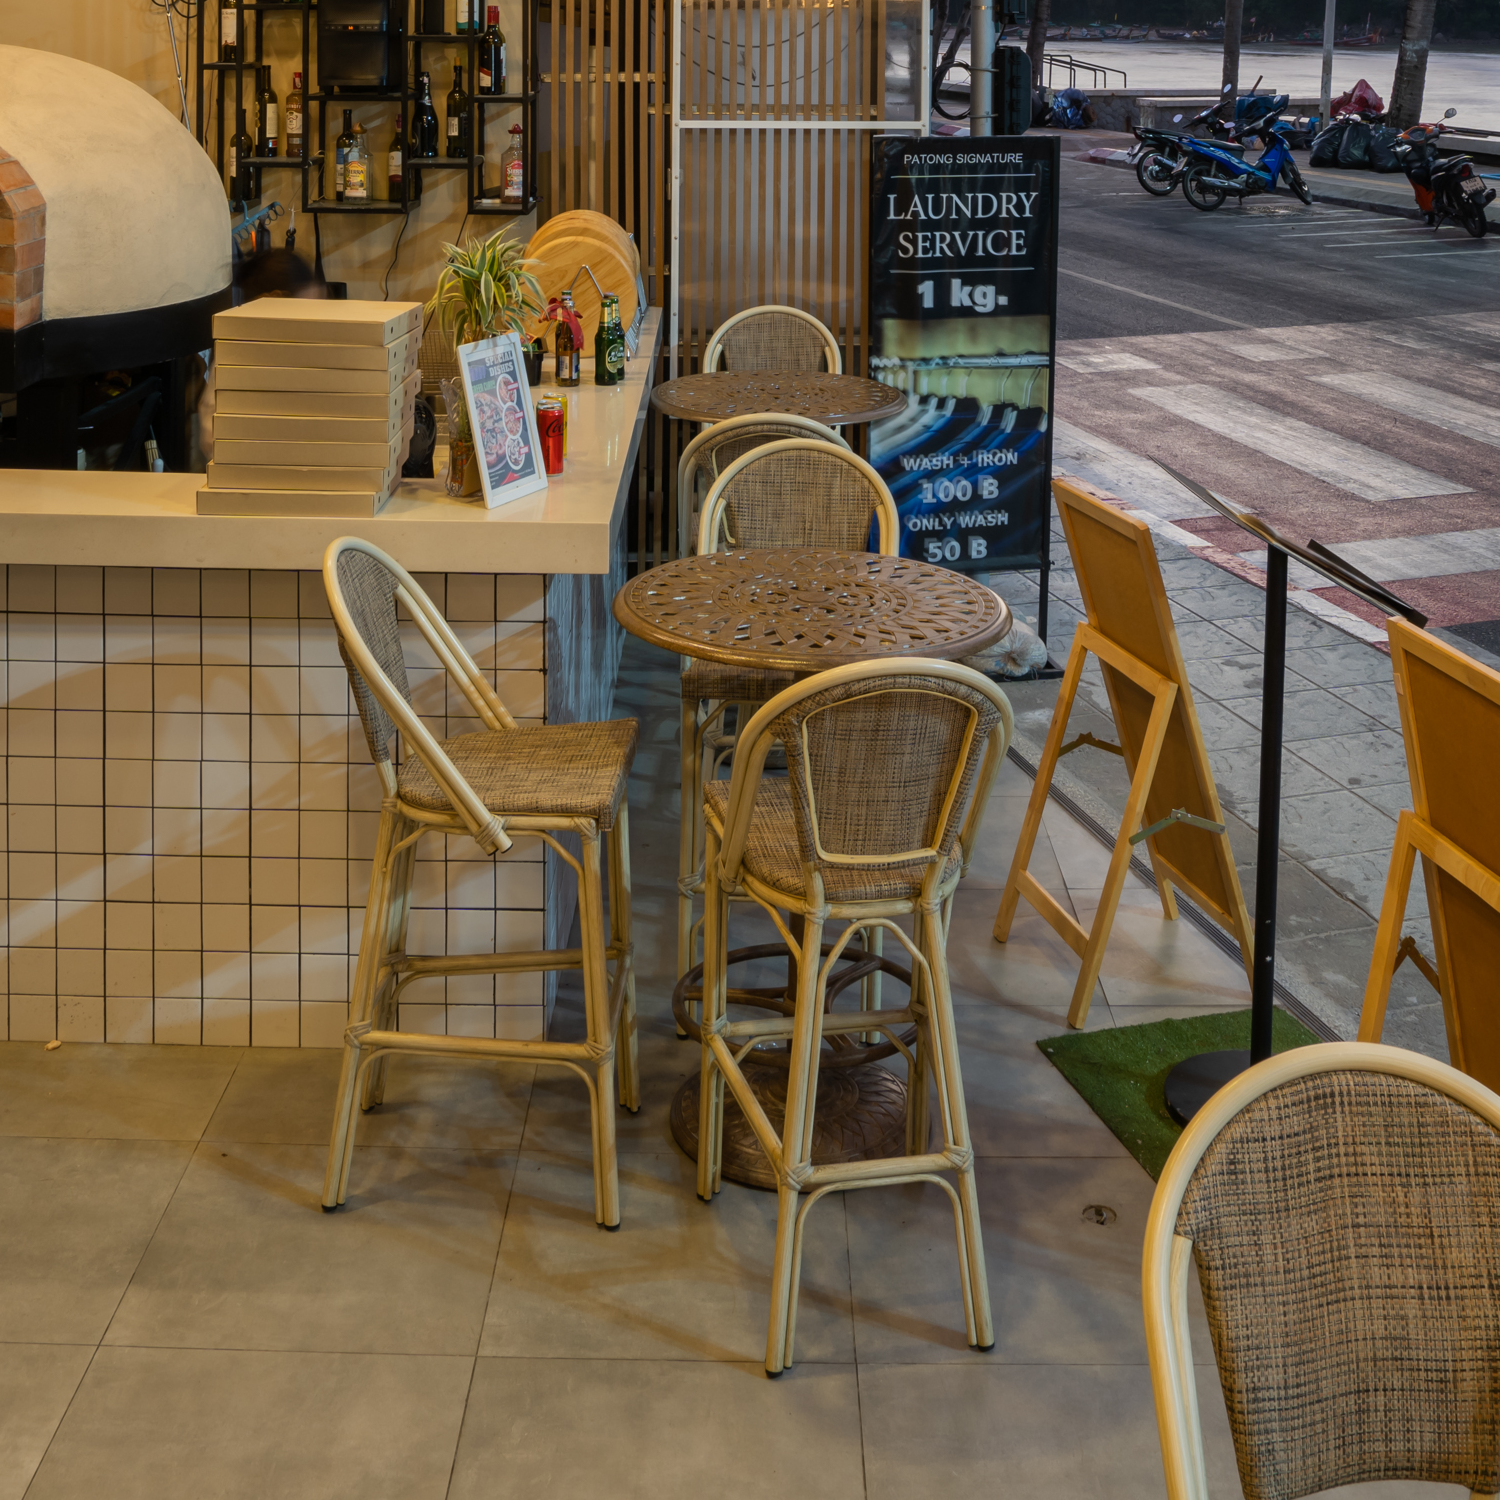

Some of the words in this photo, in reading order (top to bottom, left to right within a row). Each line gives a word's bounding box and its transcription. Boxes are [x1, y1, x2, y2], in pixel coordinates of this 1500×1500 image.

[904, 154, 953, 165] PATONG
[956, 153, 1023, 164] SIGNATURE
[886, 192, 1039, 220] LAUNDRY
[898, 229, 1027, 258] SERVICE
[916, 280, 934, 308] 1
[950, 278, 1008, 313] kg.
[485, 351, 513, 367] SPECIAL
[489, 361, 514, 377] DISHES
[903, 455, 954, 471] WASH
[978, 452, 1018, 467] IRON
[922, 480, 973, 504] 100
[982, 478, 999, 499] B
[908, 516, 955, 532] ONLY
[960, 512, 1009, 528] WASH
[927, 540, 961, 563] 50
[971, 539, 988, 560] B
